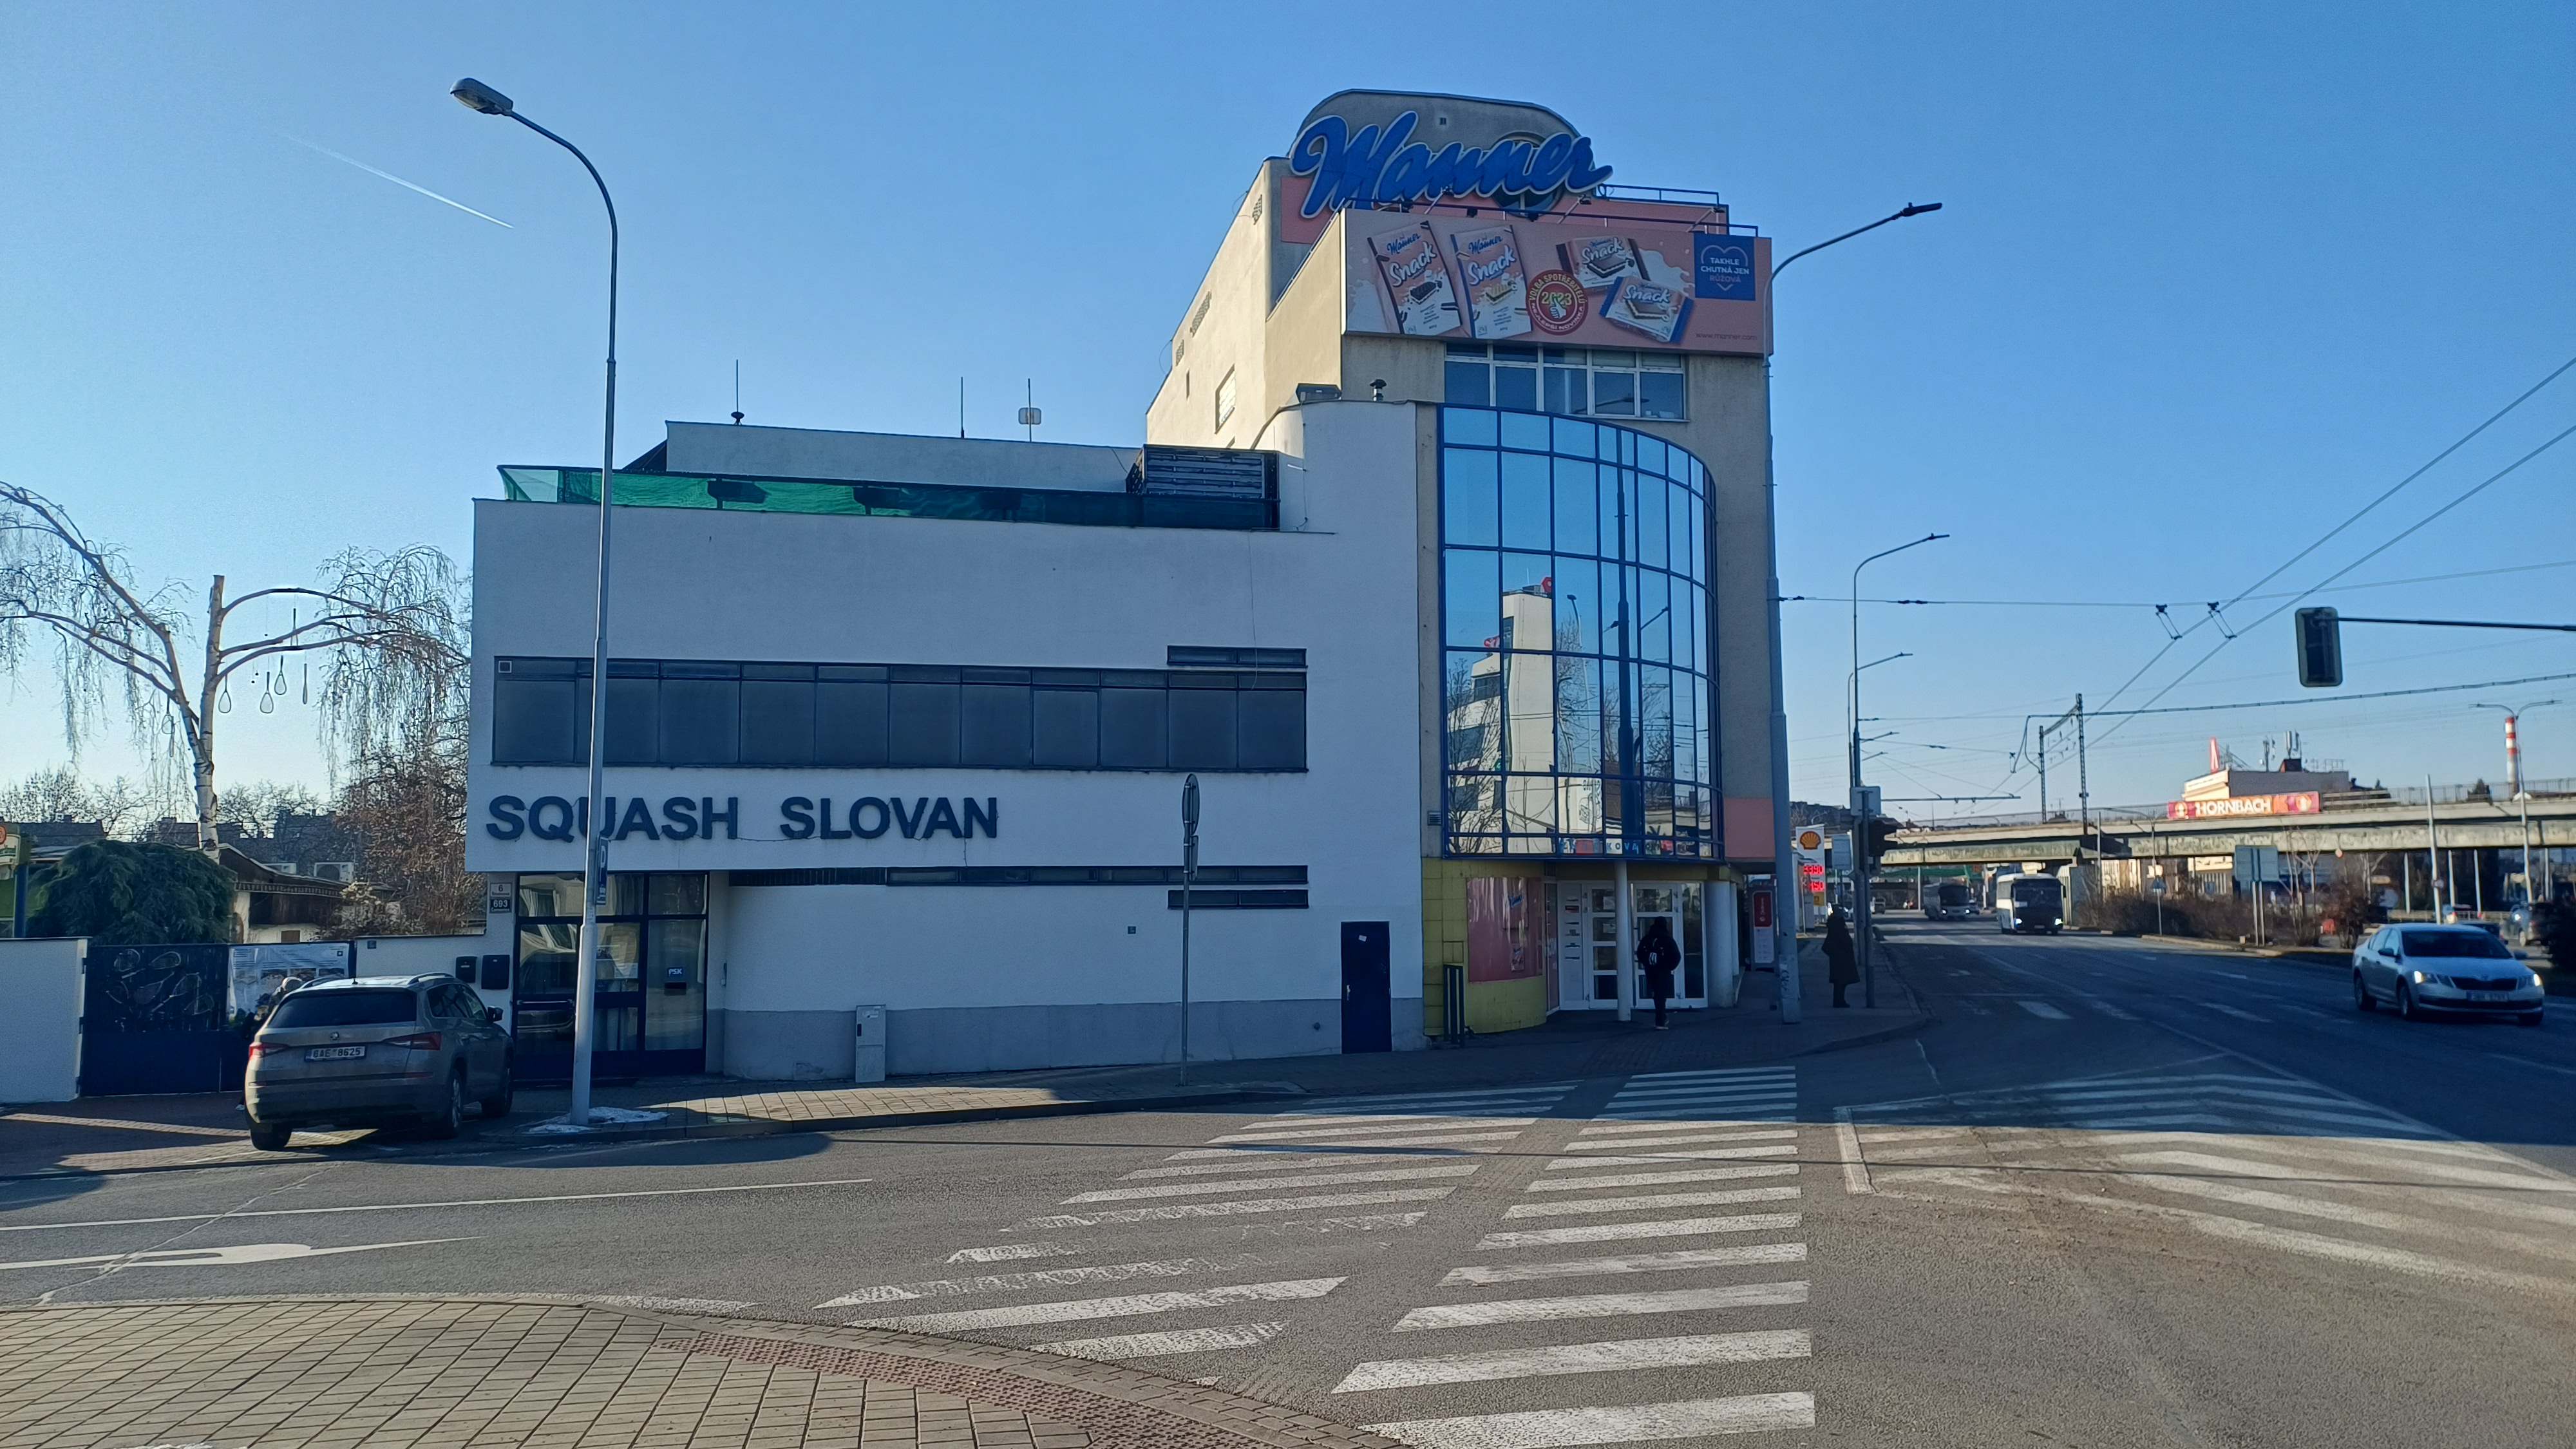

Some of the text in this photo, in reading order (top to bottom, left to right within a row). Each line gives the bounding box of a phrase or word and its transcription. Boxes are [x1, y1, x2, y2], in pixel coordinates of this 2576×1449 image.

[1289, 111, 1613, 218] Manner
[1581, 236, 1625, 264] Snack
[1710, 257, 1740, 265] TAKHLE
[1388, 241, 1437, 287] Snack
[1467, 244, 1516, 286] Snack
[1700, 265, 1733, 274] CHUTNÁ
[1623, 284, 1672, 303] Snack
[2195, 797, 2271, 815] HORNBACH
[486, 795, 998, 843] SQUASH SLOVAN
[337, 1047, 361, 1057] 8625
